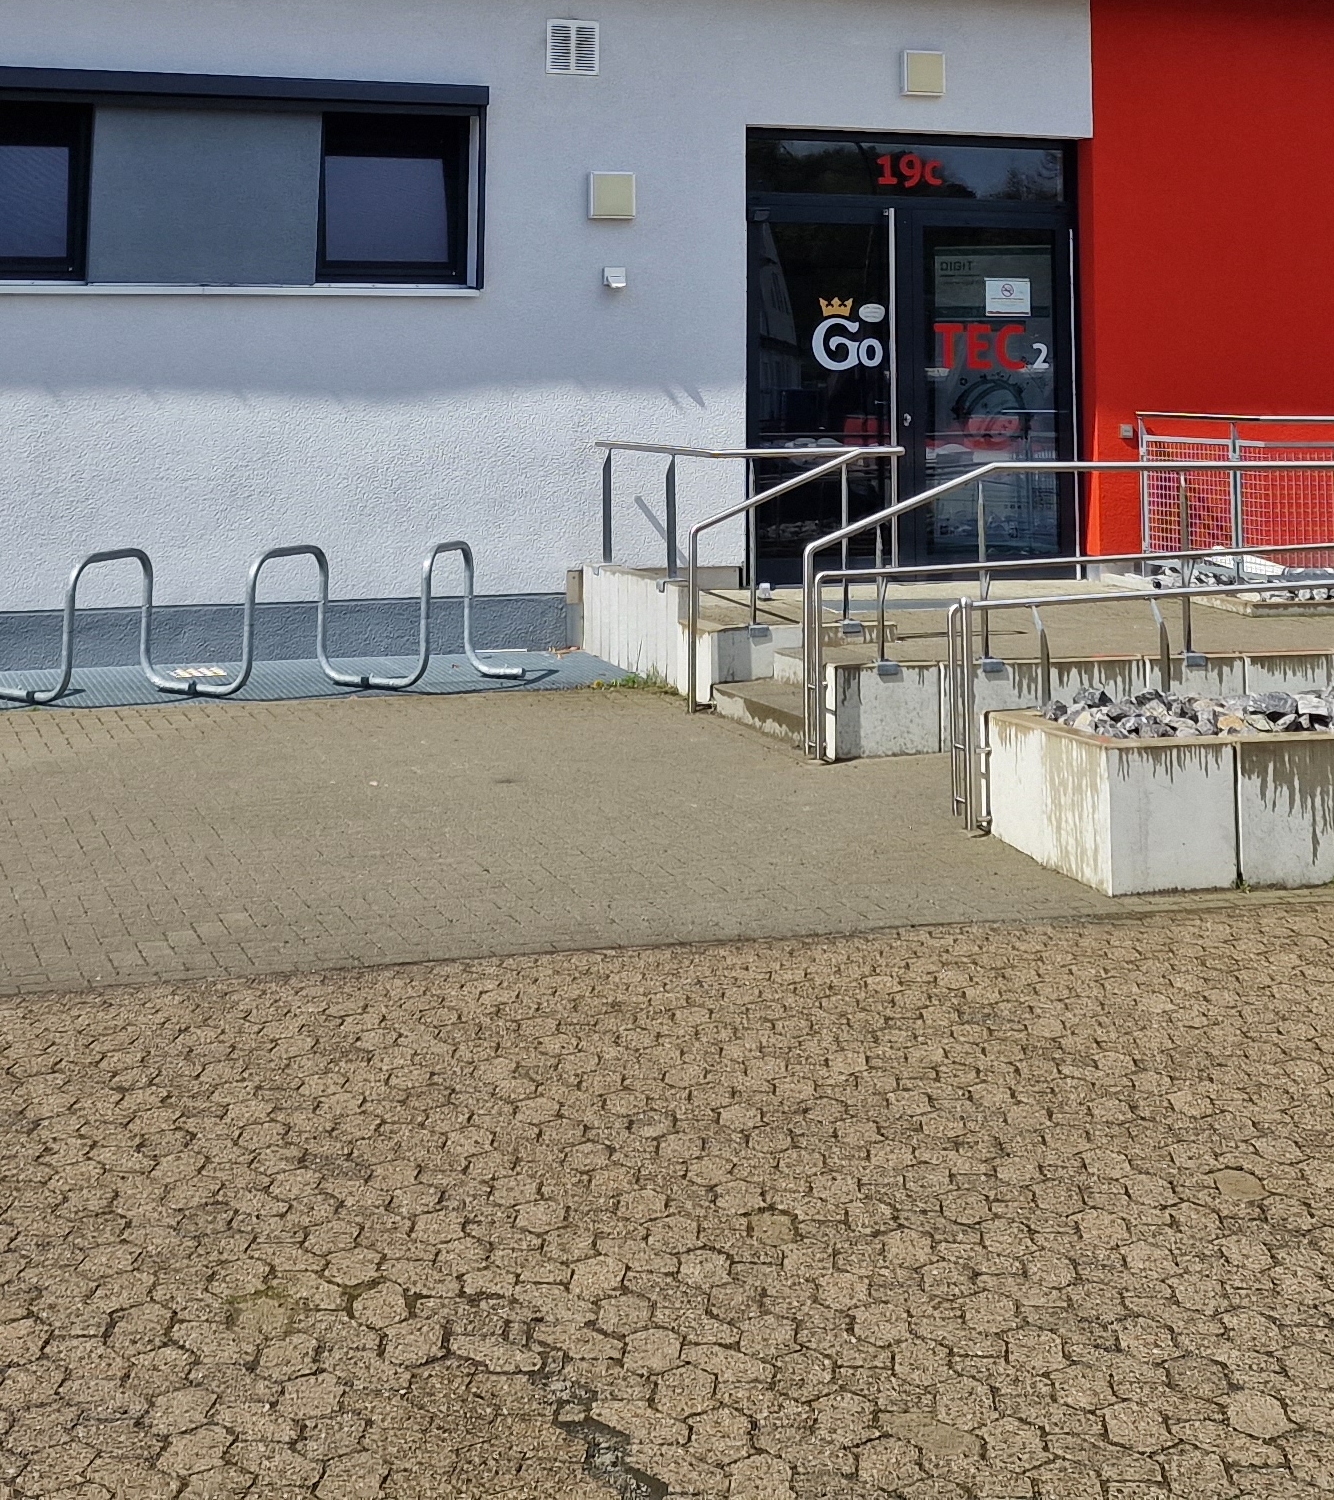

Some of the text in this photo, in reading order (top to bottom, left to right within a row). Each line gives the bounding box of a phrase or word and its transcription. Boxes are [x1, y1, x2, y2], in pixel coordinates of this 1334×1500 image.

[876, 153, 943, 188] 19c
[812, 317, 884, 371] Go
[933, 322, 1026, 372] TEC
